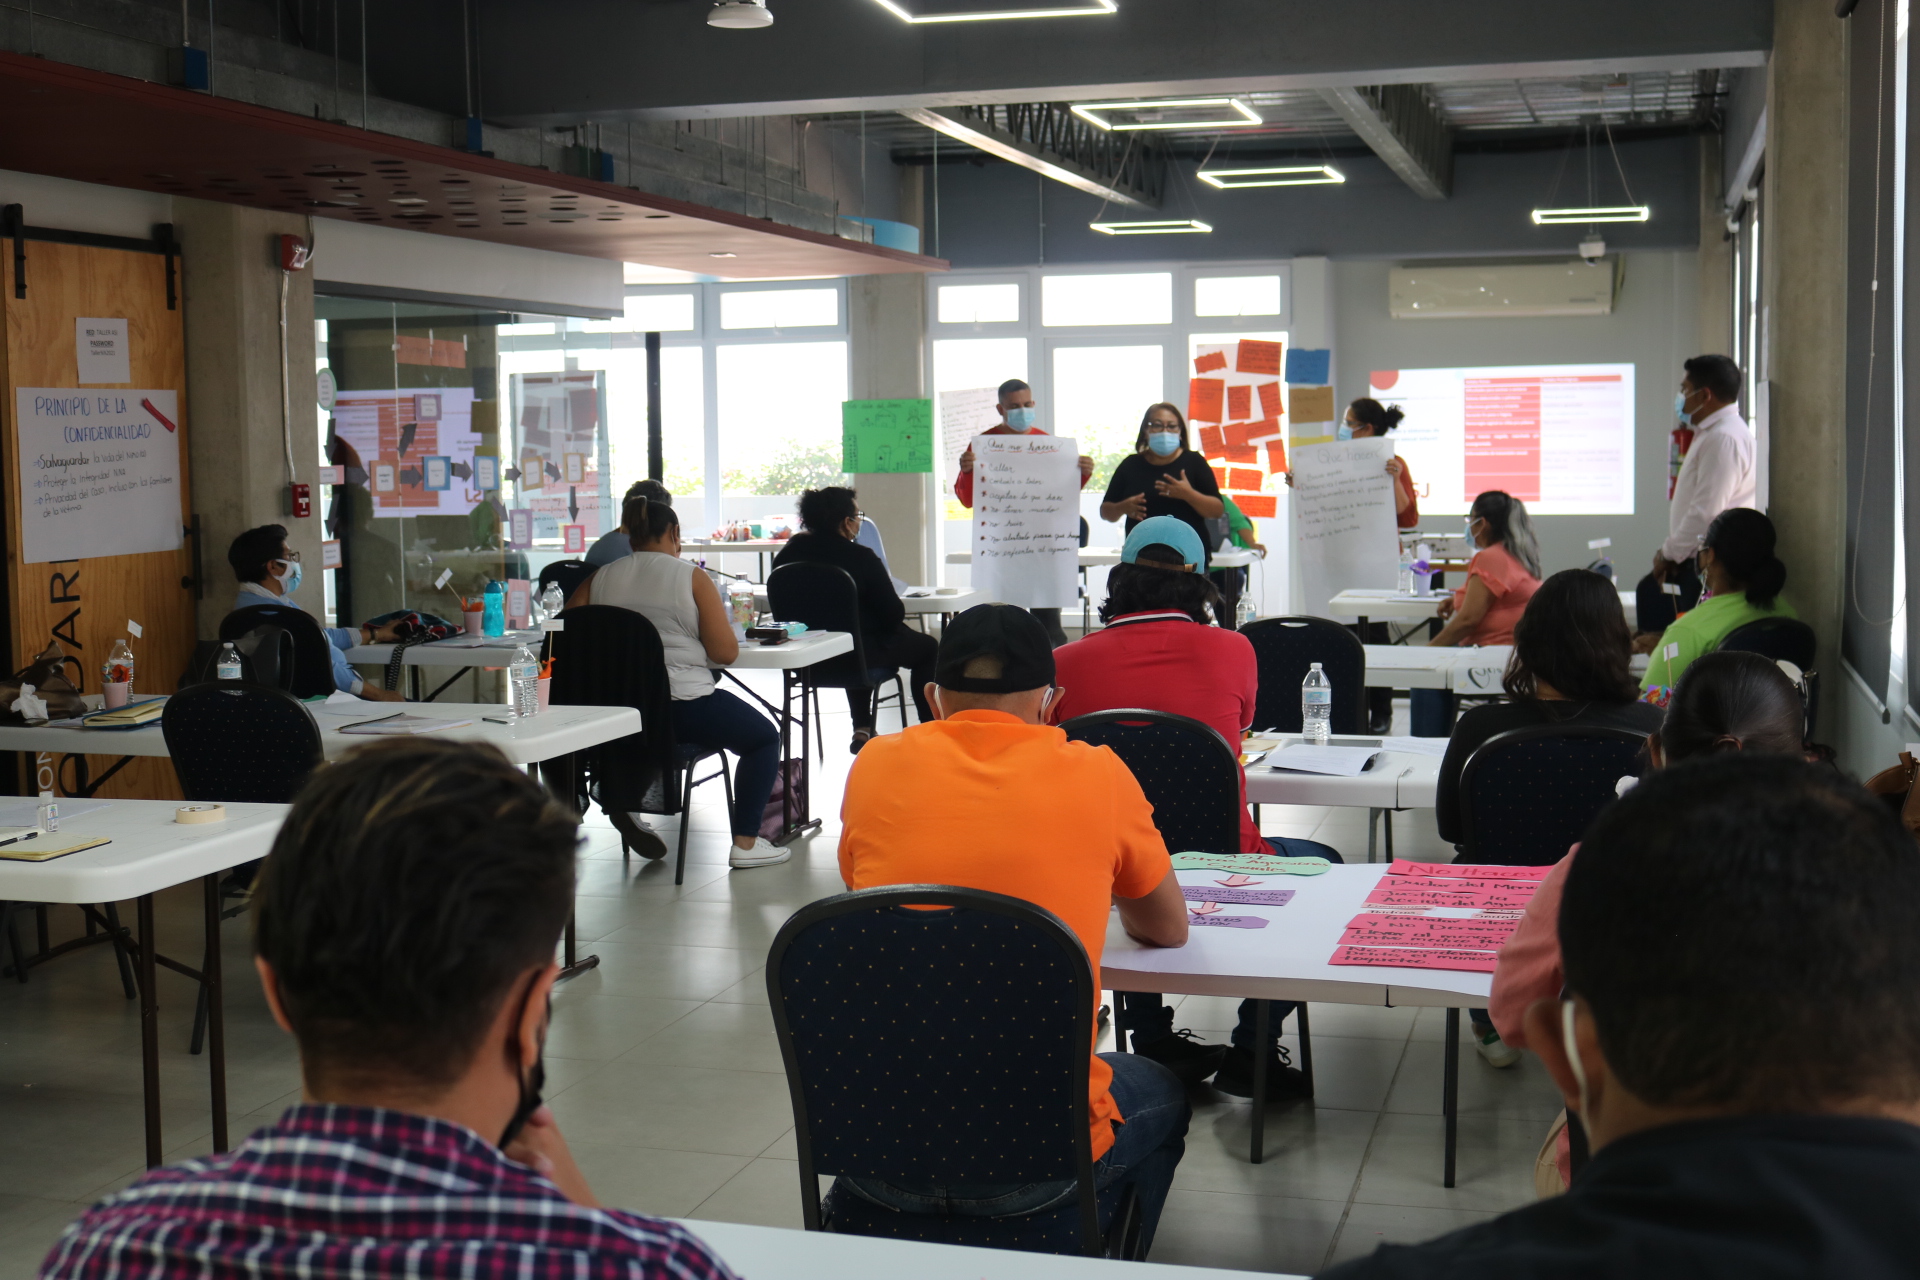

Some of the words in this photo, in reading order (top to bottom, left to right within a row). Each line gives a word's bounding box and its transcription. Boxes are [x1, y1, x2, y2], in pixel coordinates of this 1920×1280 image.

[35, 396, 91, 416] PRINCIPIO
[98, 397, 110, 414] DE
[116, 398, 128, 414] LA
[64, 423, 152, 444] CONFIDENCIALIDAD
[39, 451, 89, 473] Salvaguardar
[93, 450, 101, 463] la
[43, 474, 68, 491] Proteger
[1428, 924, 1515, 932] Denuncia
